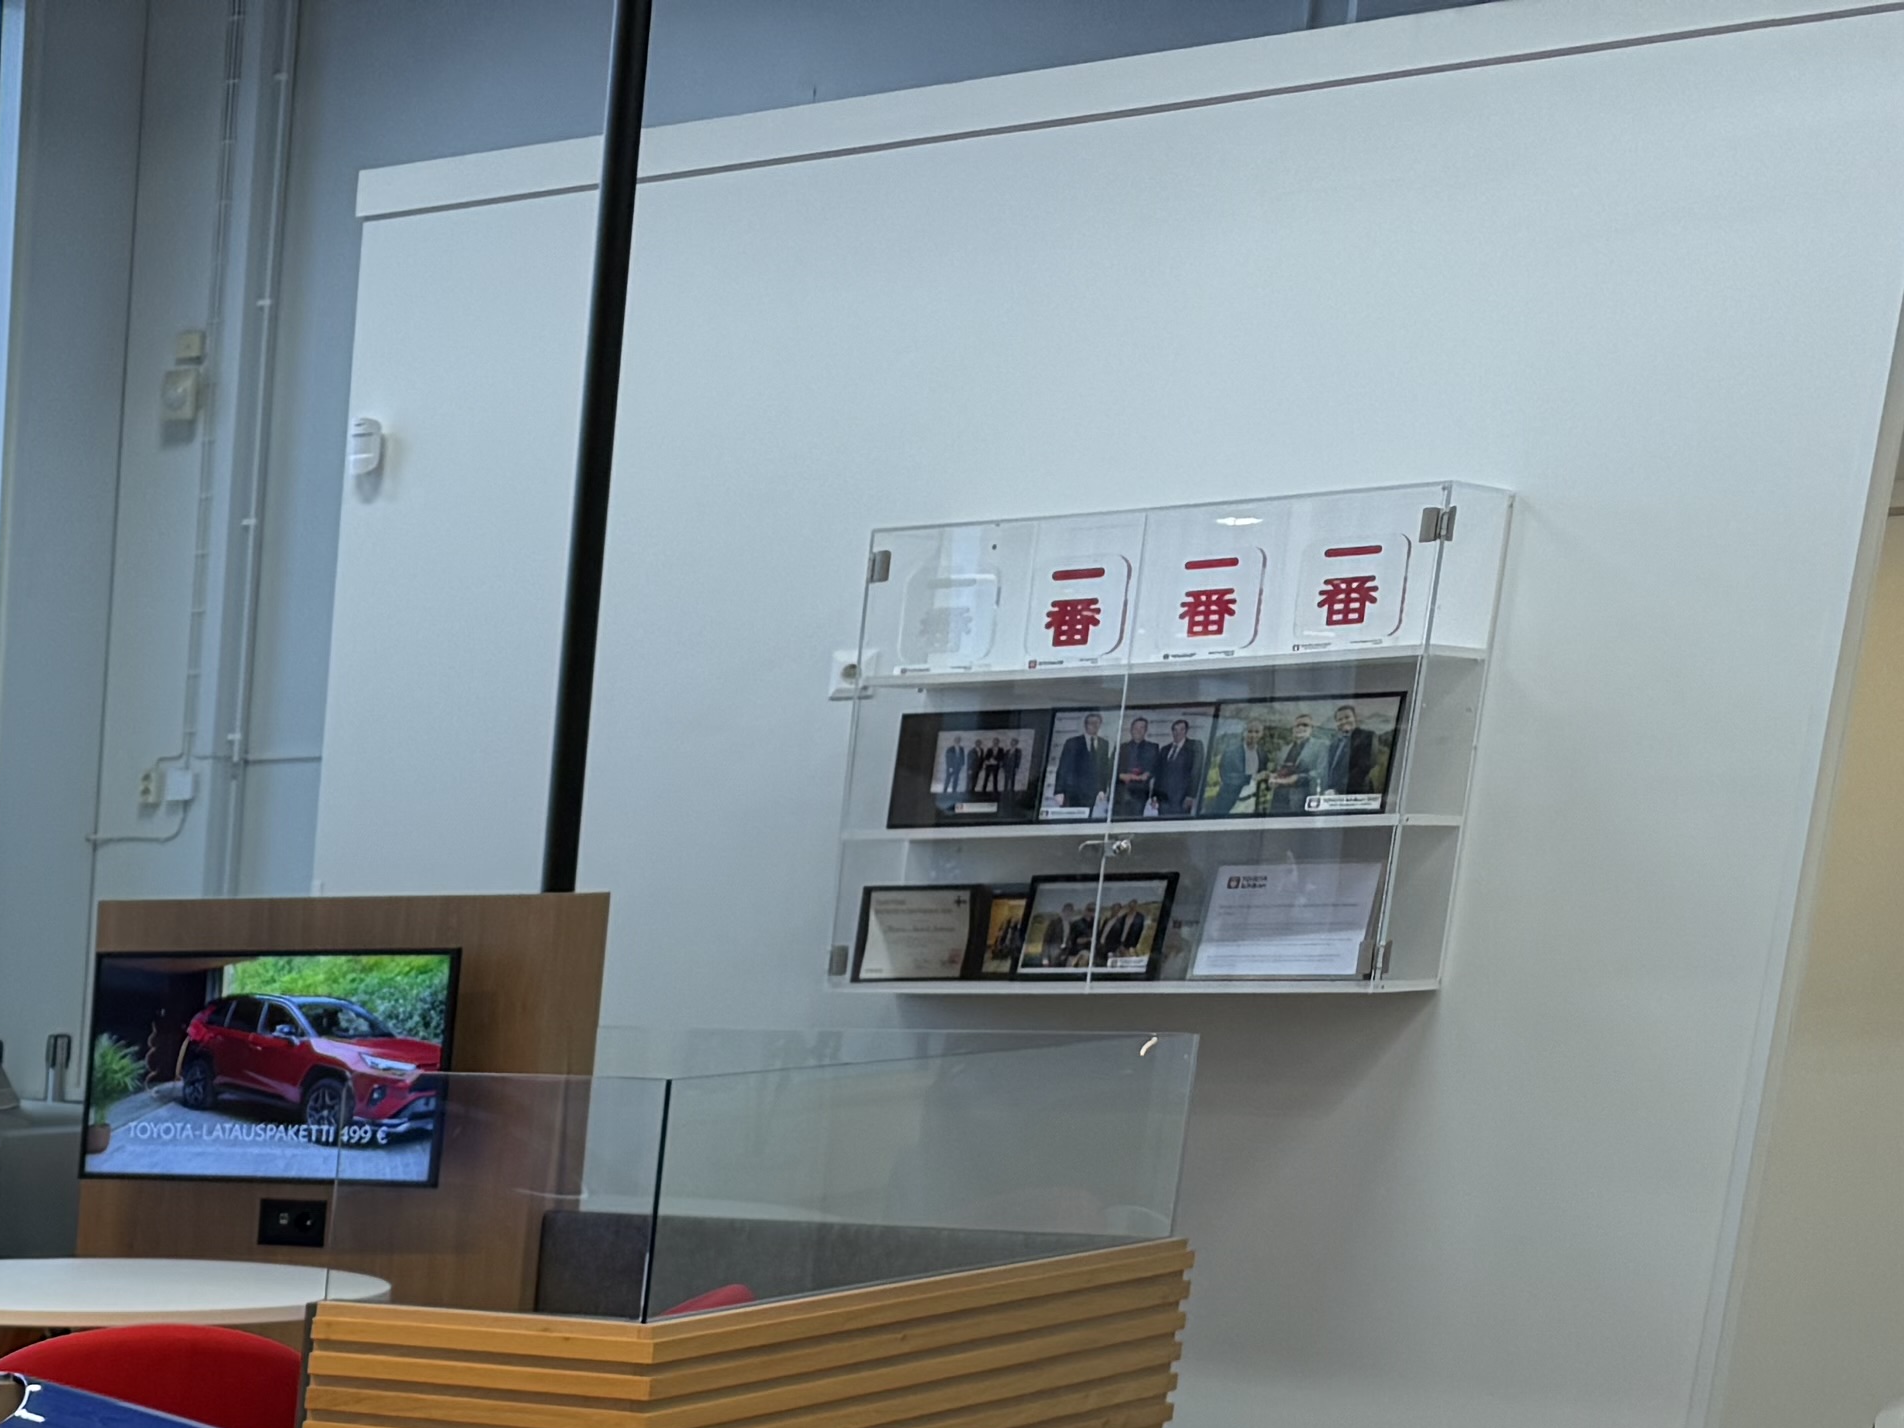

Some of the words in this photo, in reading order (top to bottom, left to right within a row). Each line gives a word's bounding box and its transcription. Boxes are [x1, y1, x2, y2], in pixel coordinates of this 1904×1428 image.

[1179, 557, 1239, 637] 一番
[1317, 545, 1383, 626] 一番
[129, 1121, 334, 1142] TOYOTA-LATAUSPAKETTI
[340, 1125, 372, 1143] 499
[377, 1126, 389, 1144] €
